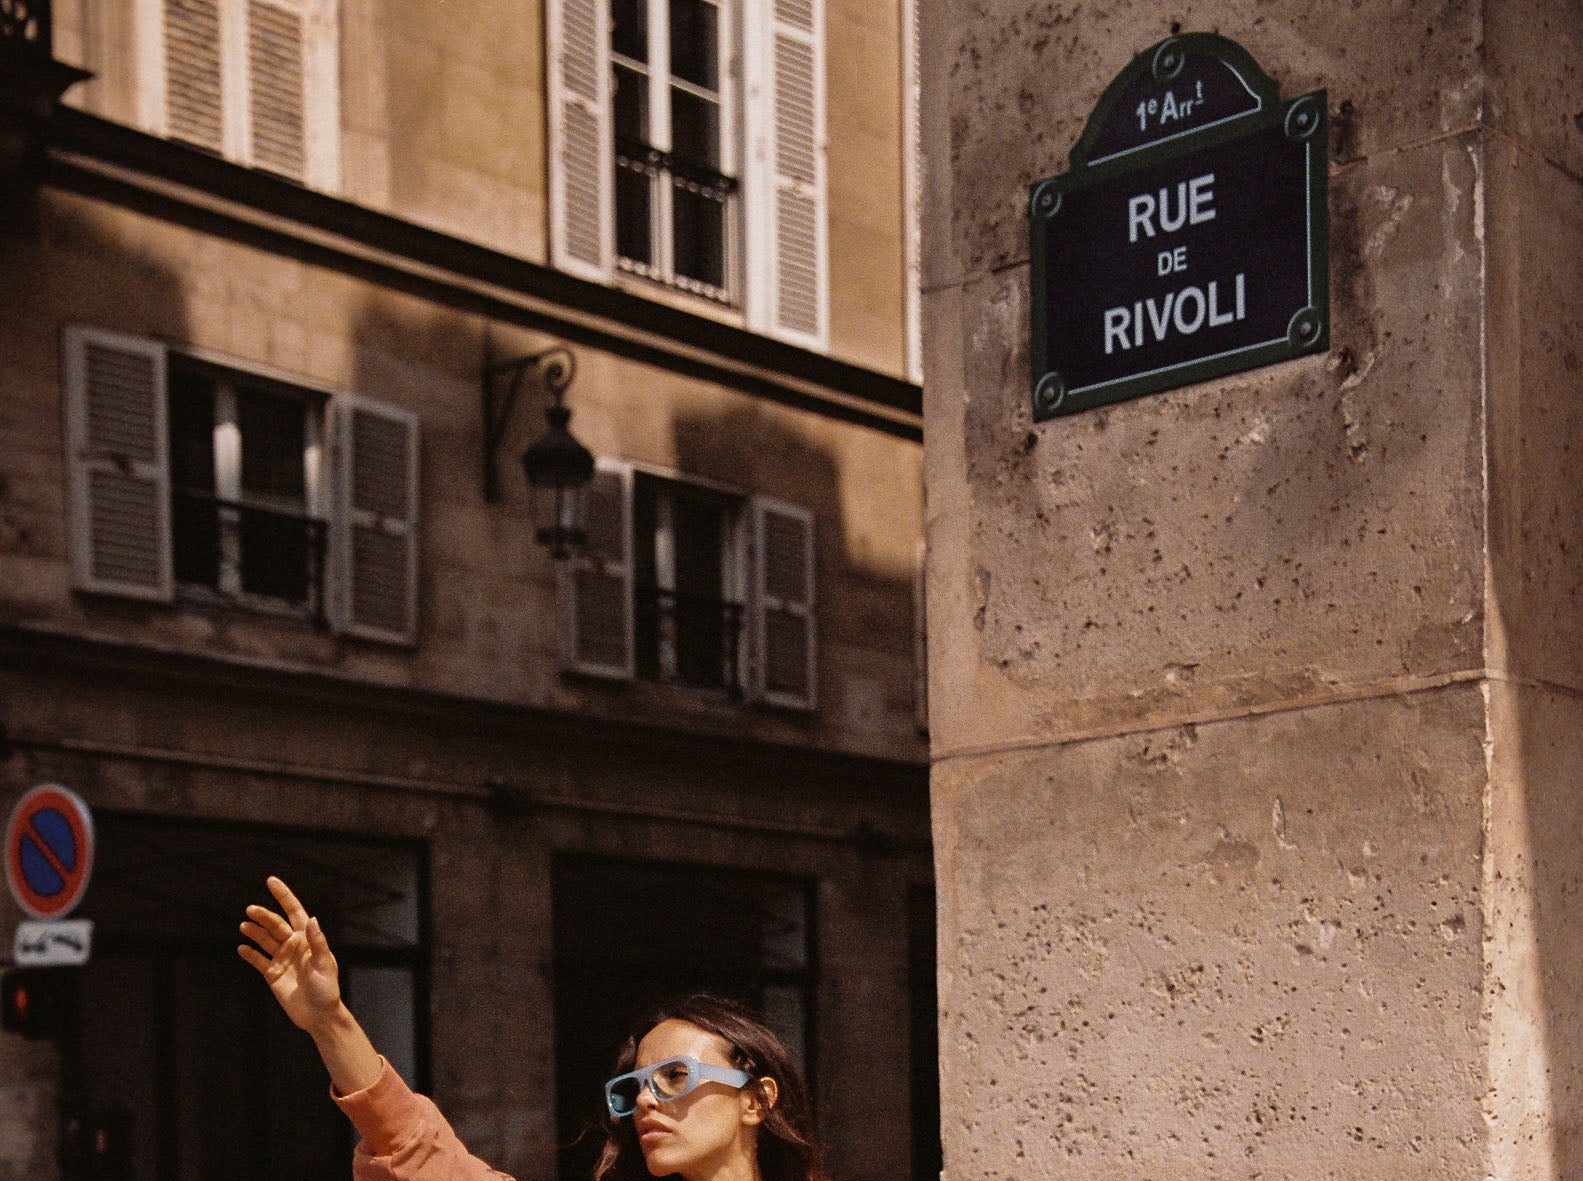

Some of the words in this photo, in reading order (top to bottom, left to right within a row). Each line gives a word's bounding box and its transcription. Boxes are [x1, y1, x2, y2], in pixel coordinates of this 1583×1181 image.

[1128, 173, 1217, 243] RUE
[1157, 246, 1188, 277] DE
[1104, 273, 1246, 355] RIVOLI
